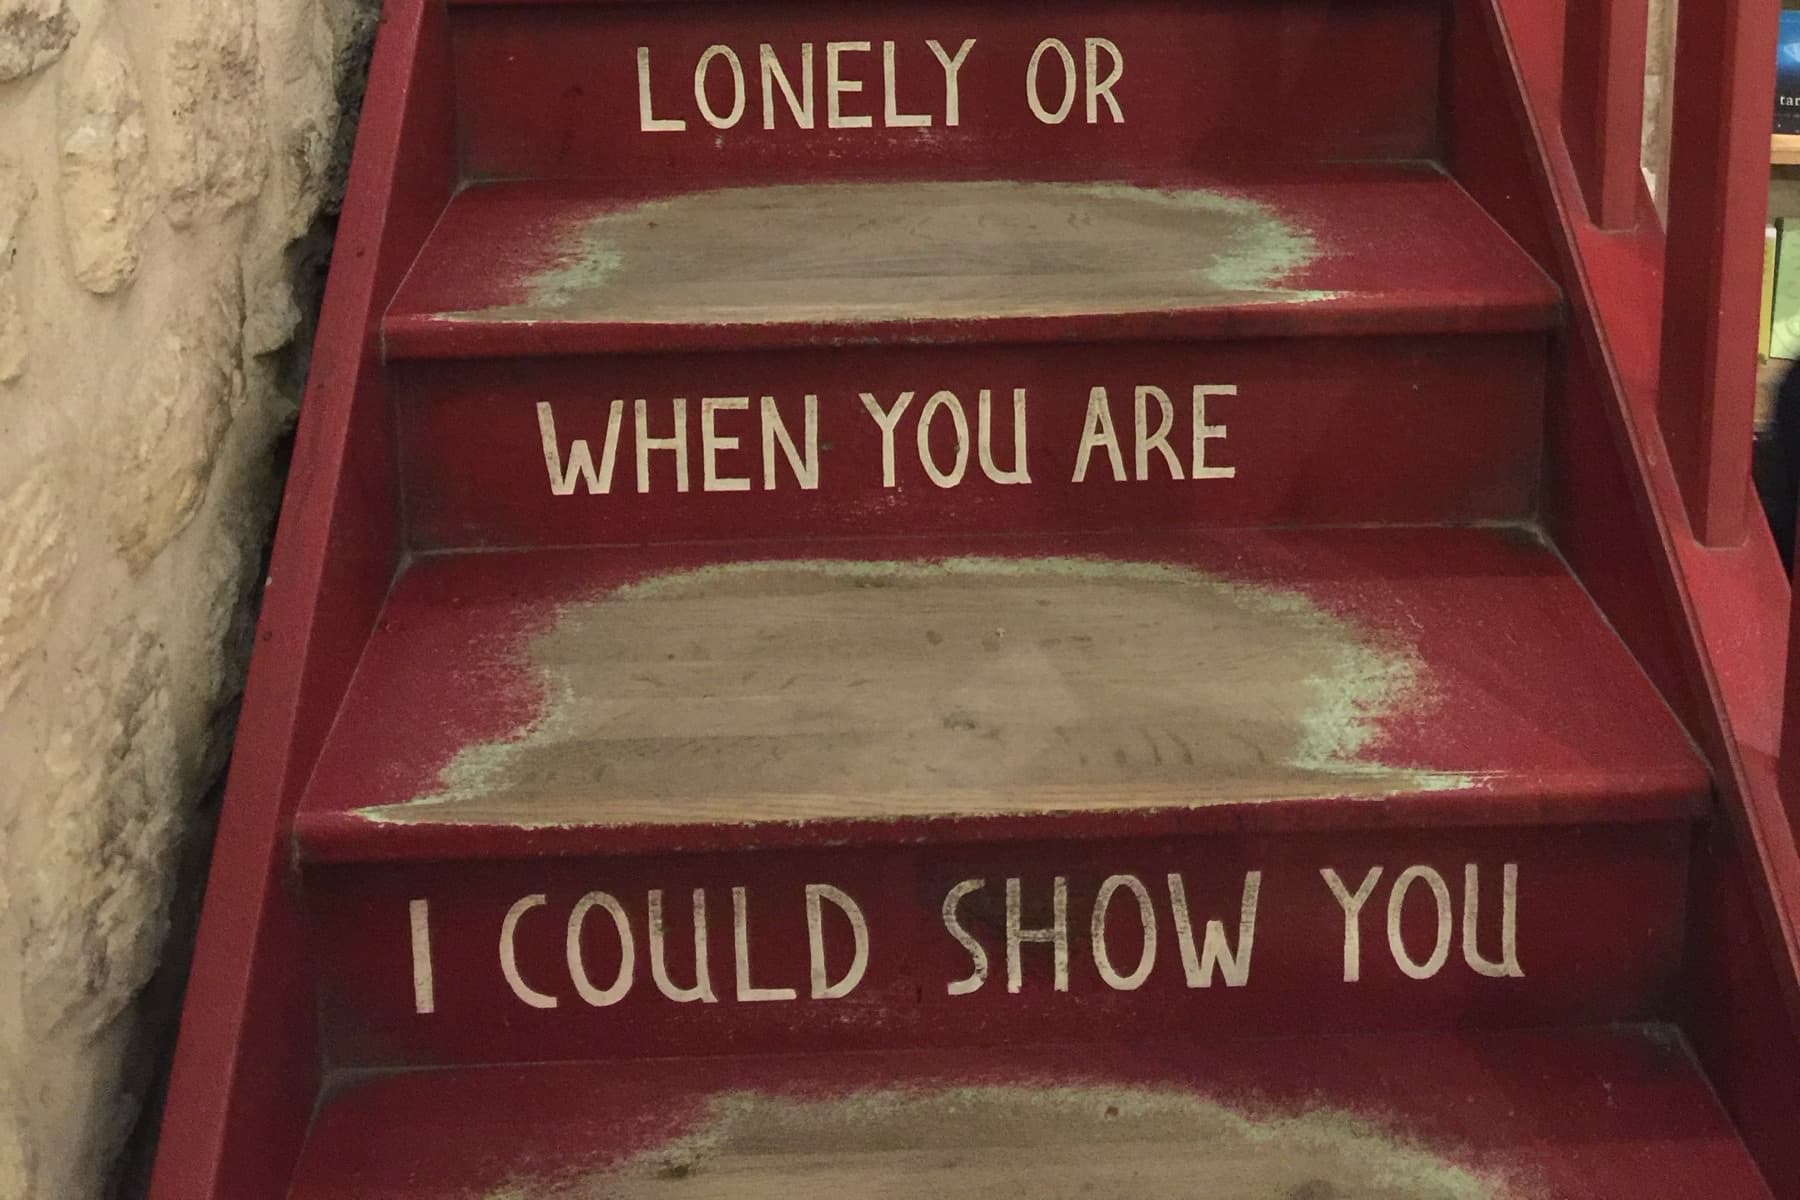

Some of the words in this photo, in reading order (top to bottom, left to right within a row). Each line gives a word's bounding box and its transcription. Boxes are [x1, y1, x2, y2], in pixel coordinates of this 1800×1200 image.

[637, 38, 977, 132] LONELY
[1026, 37, 1125, 124] OR
[536, 393, 820, 497] WHEN
[859, 387, 1032, 489] YOU
[1071, 383, 1237, 482] ARE
[409, 899, 435, 1014] I
[499, 883, 869, 1009] COULD
[941, 870, 1262, 996] SHOW
[1320, 862, 1524, 981] YOU
